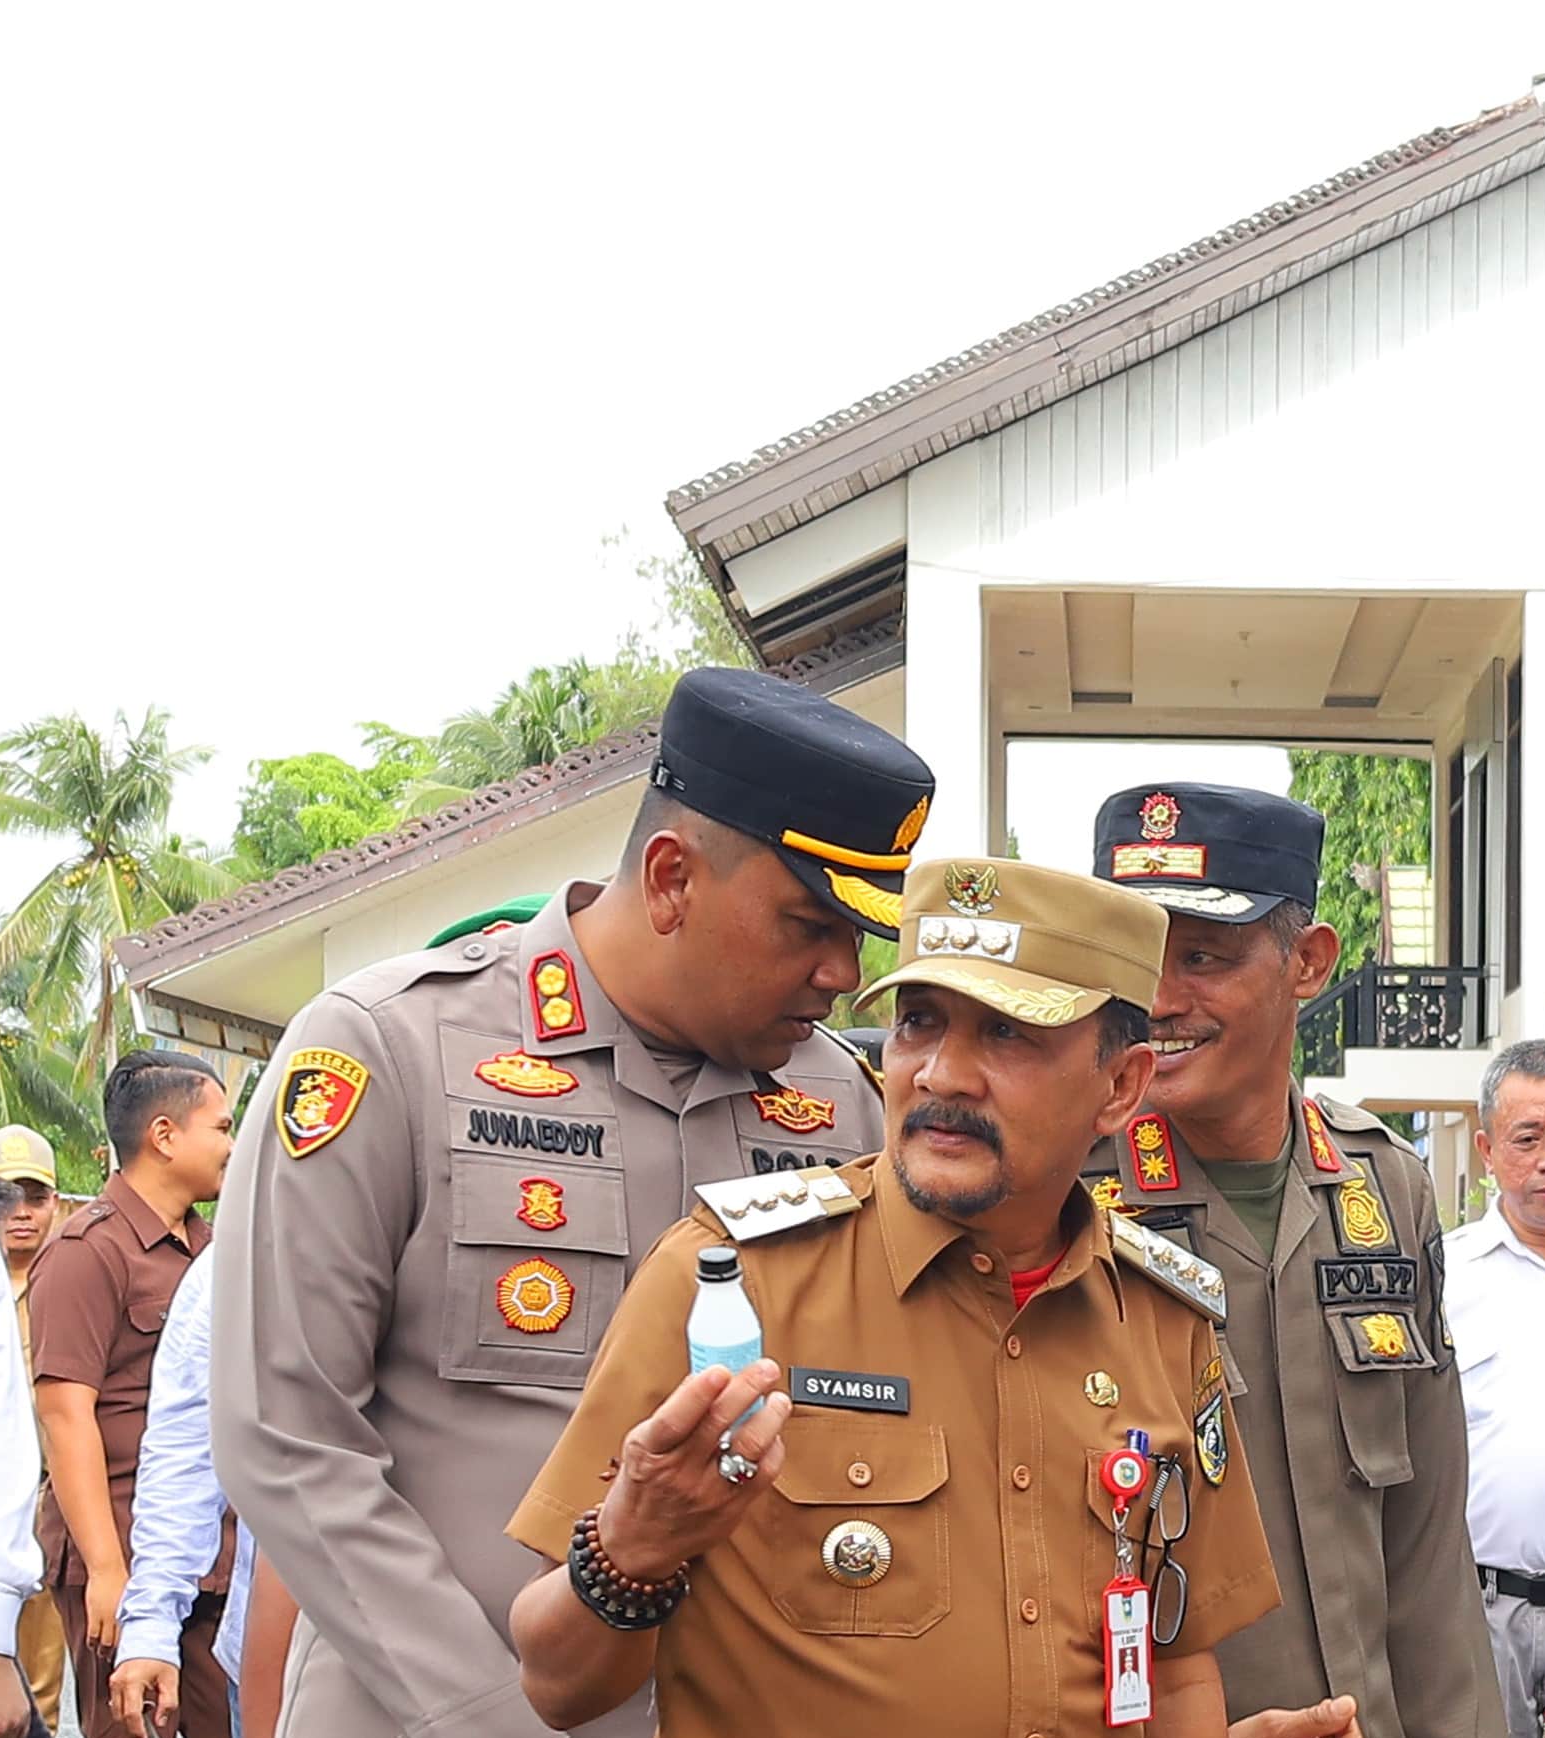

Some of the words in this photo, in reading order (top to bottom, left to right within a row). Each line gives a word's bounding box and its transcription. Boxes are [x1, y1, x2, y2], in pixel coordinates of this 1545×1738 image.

[468, 1109, 605, 1158] JUNAEDDY
[1325, 1264, 1382, 1297] POL
[1384, 1264, 1412, 1295] PP
[805, 1376, 897, 1402] SYAMSIR
